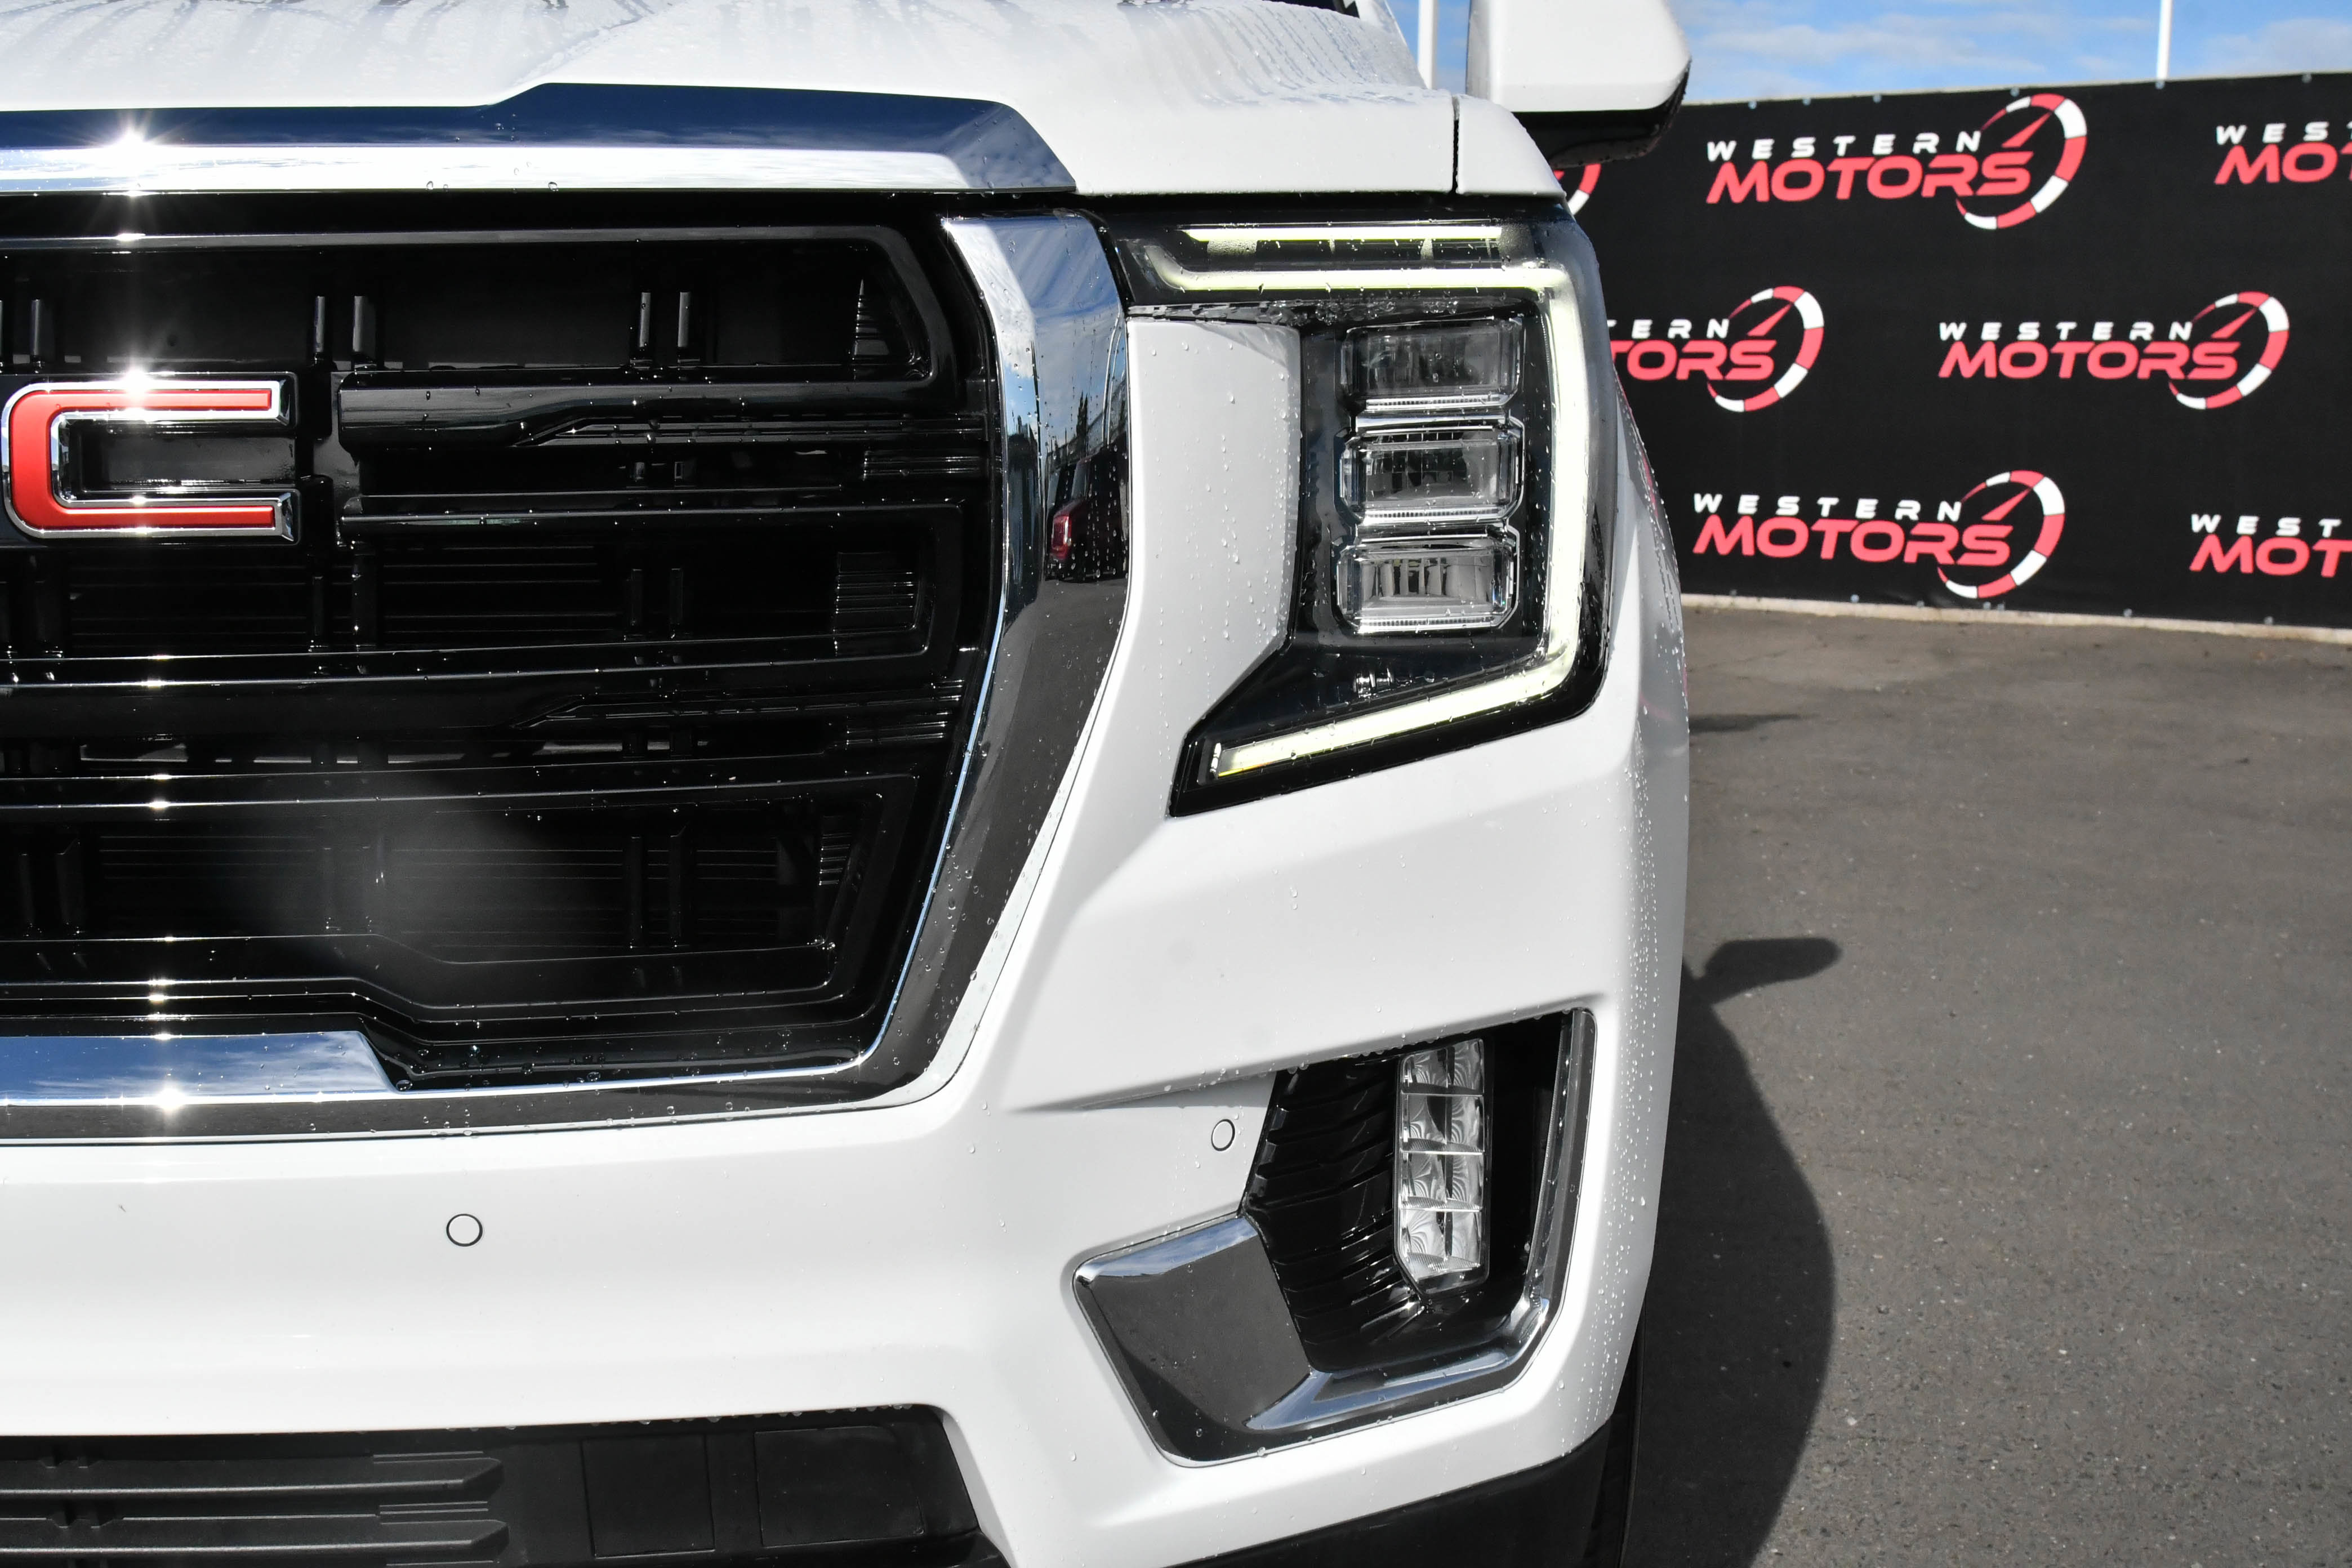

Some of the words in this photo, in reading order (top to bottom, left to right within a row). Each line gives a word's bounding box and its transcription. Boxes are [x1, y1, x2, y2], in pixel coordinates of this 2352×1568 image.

[1707, 130, 1981, 162] WESTERN
[2214, 141, 2352, 185] MO
[1706, 151, 2034, 204] MOTORS
[1939, 321, 2193, 341] WESTERN
[1938, 340, 2240, 380] MOTORS
[1693, 493, 1962, 522] WESTERN
[2190, 513, 2342, 538] WEST
[1692, 514, 2014, 567] MOTORS
